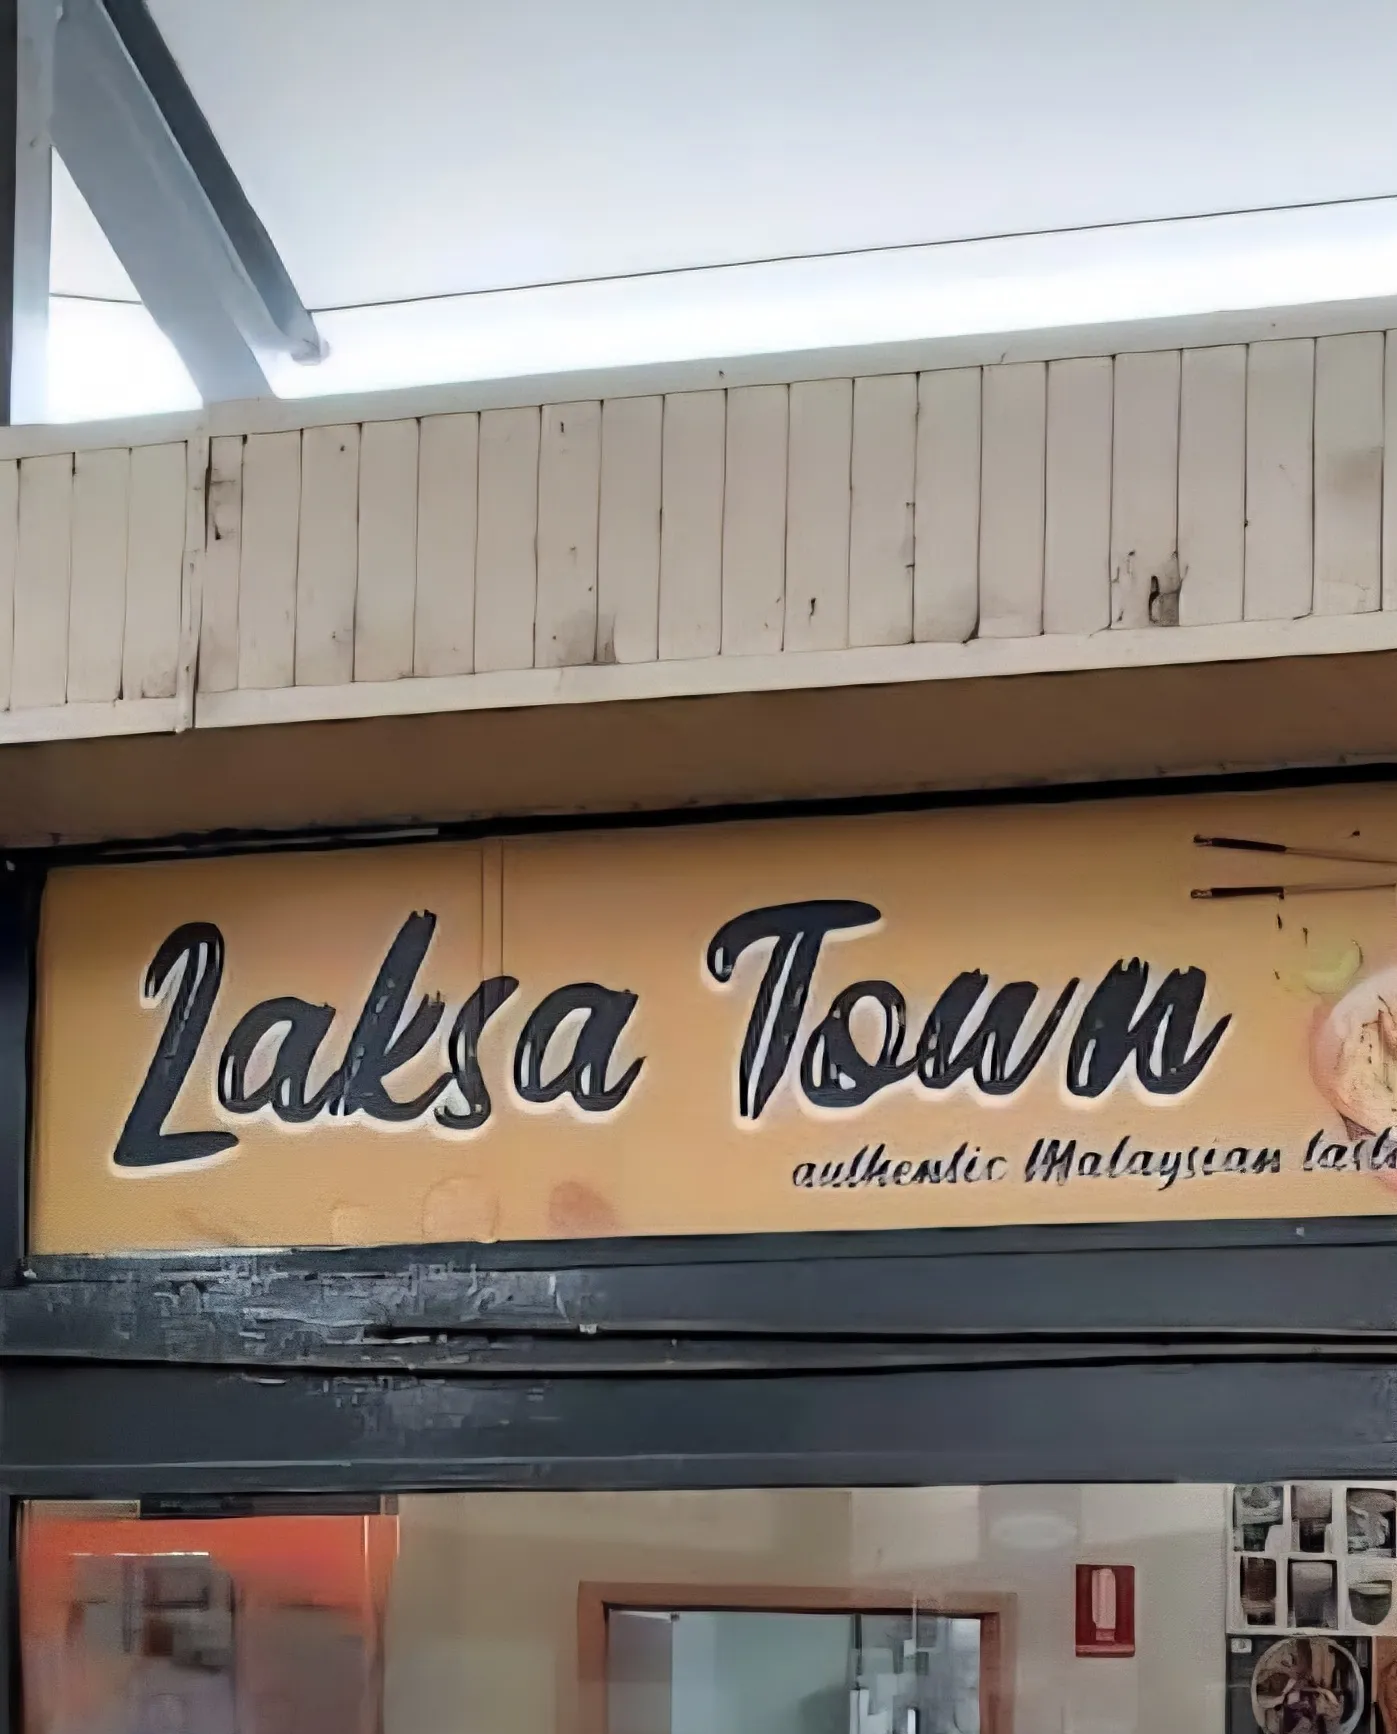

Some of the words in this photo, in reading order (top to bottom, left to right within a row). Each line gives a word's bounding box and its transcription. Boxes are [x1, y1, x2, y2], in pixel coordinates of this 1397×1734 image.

[112, 908, 647, 1168] Laksa
[706, 899, 1234, 1120] Town
[792, 1143, 1007, 1189] authentic
[1024, 1134, 1281, 1192] Malaysian
